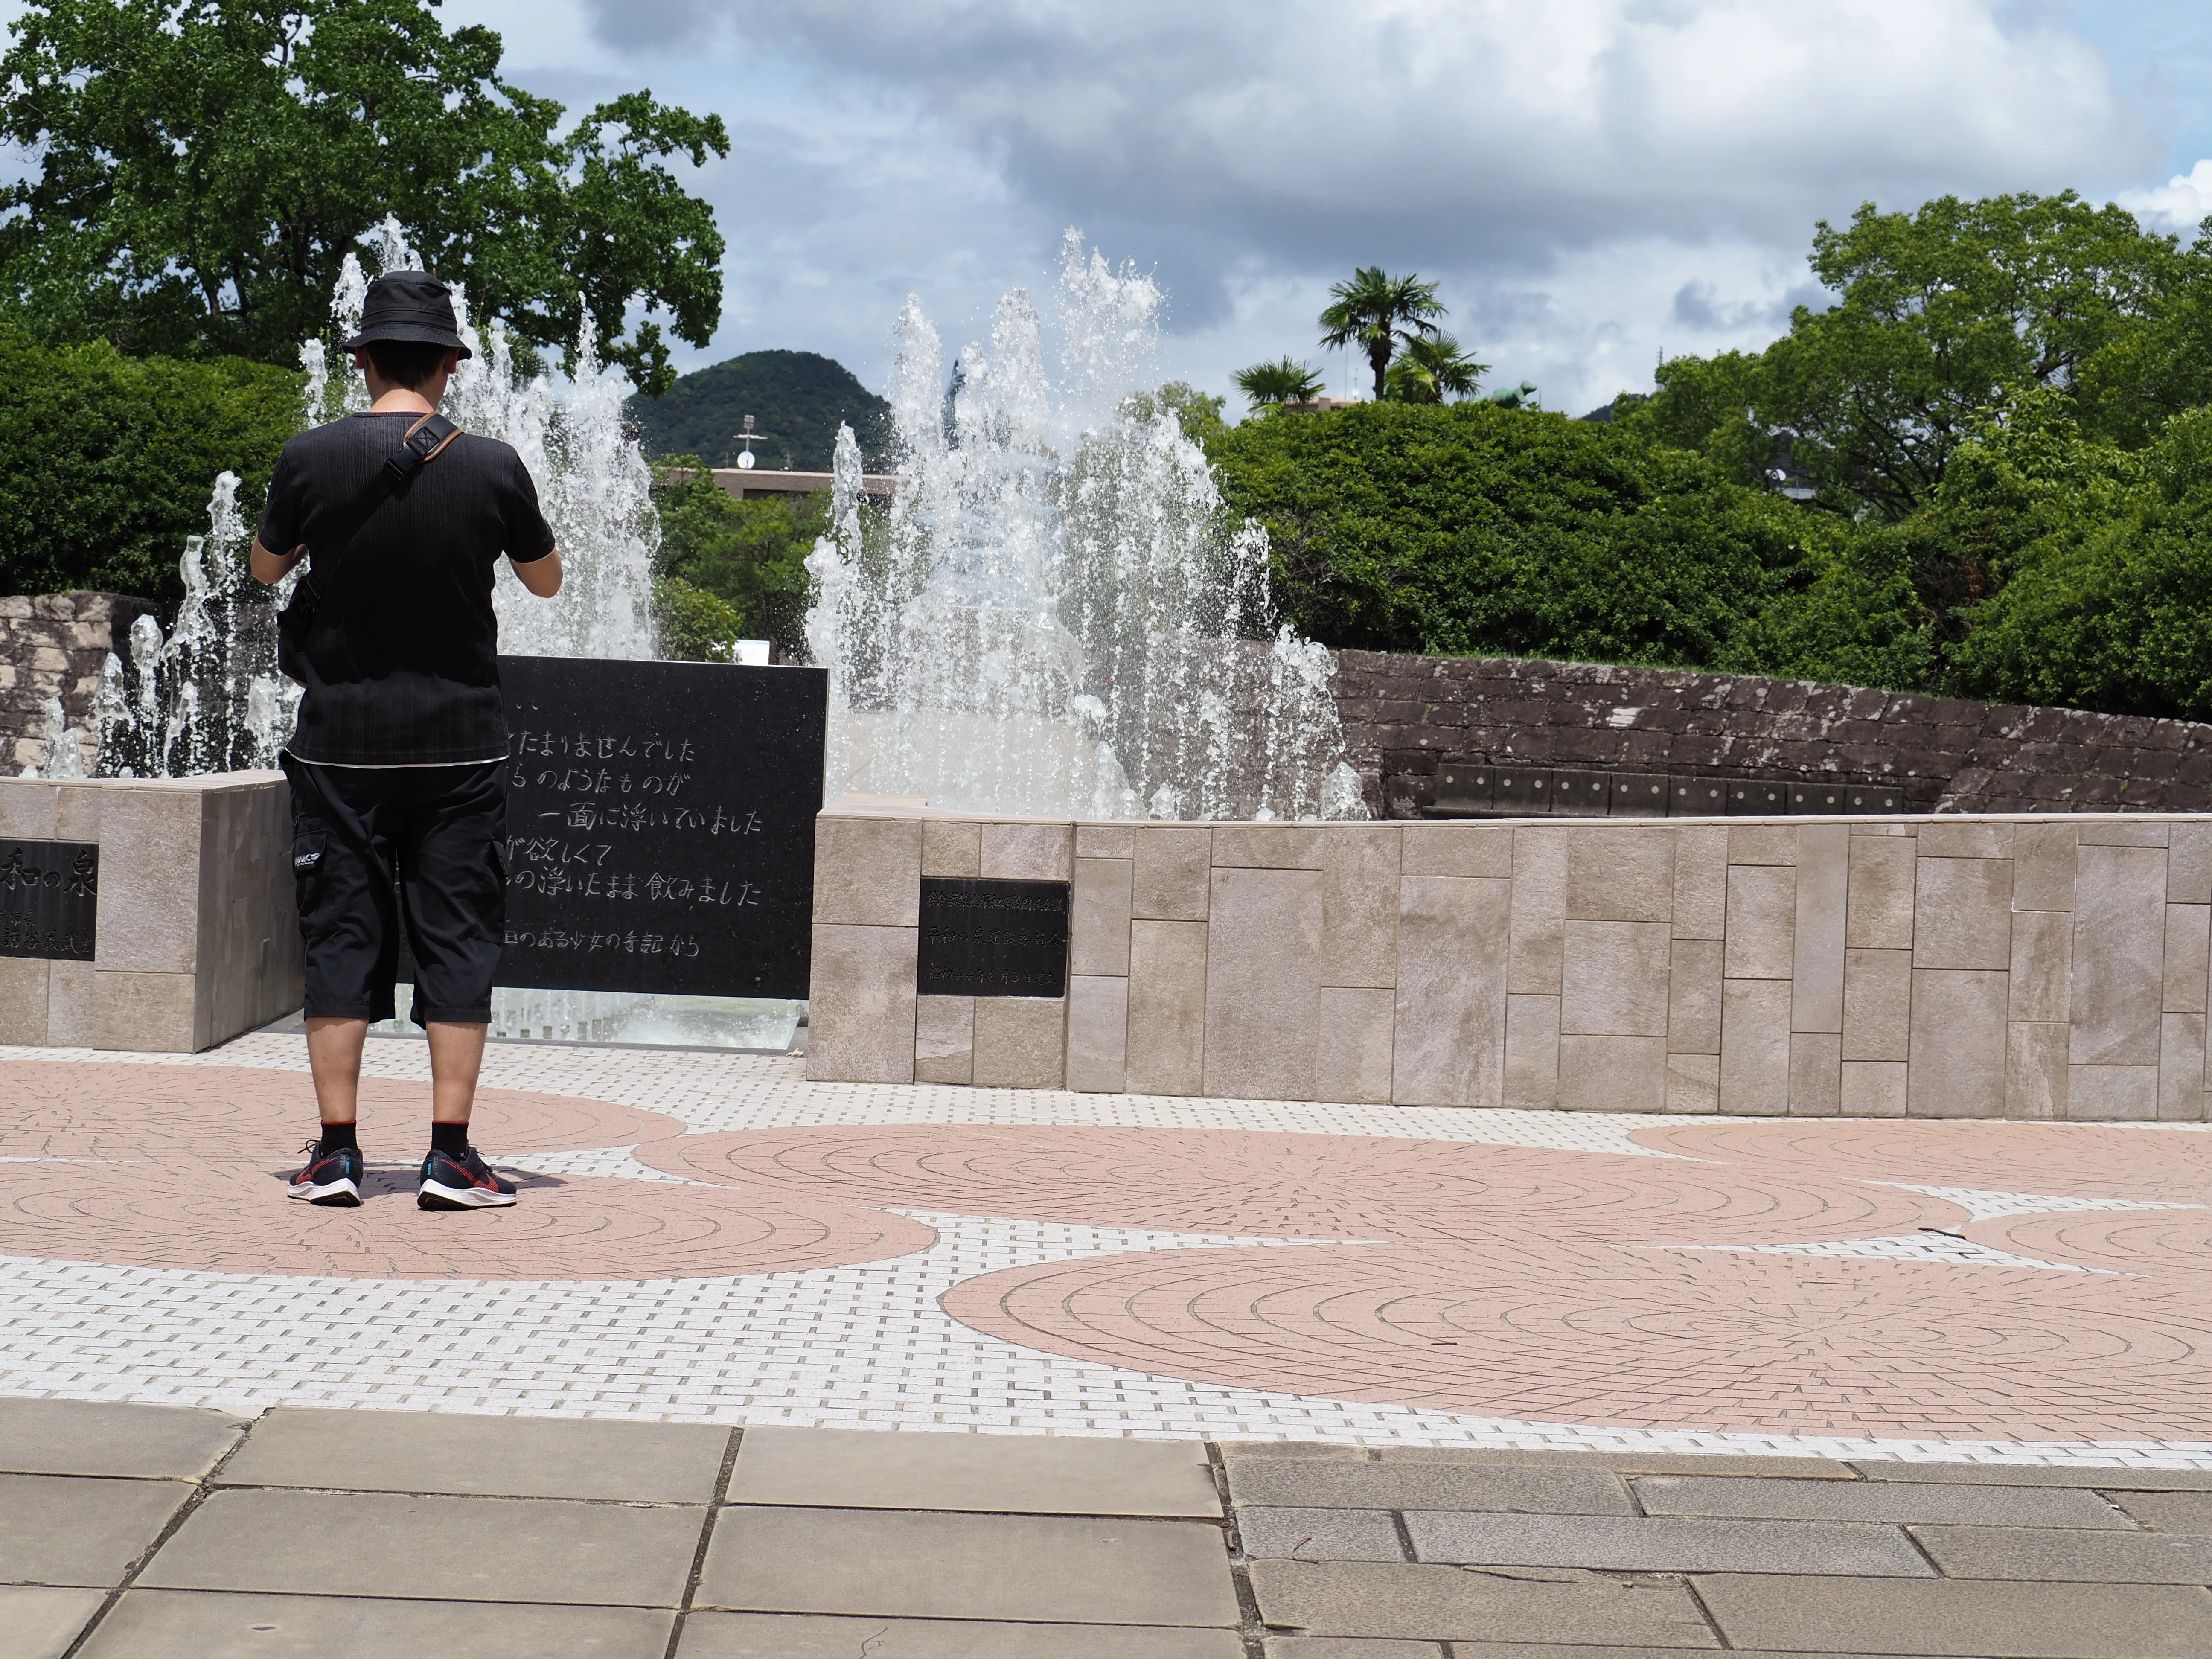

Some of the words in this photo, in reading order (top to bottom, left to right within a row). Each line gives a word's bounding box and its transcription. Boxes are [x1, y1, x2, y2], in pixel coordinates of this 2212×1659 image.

[508, 730, 695, 762] たまりませんでした
[506, 763, 691, 796] らのようなものが
[537, 802, 761, 835] 一面に浮いていました
[0, 847, 98, 897] 和の泉
[506, 865, 761, 907] の浮いたまま飲みました
[925, 926, 1066, 948] 平和の泉建設委員会
